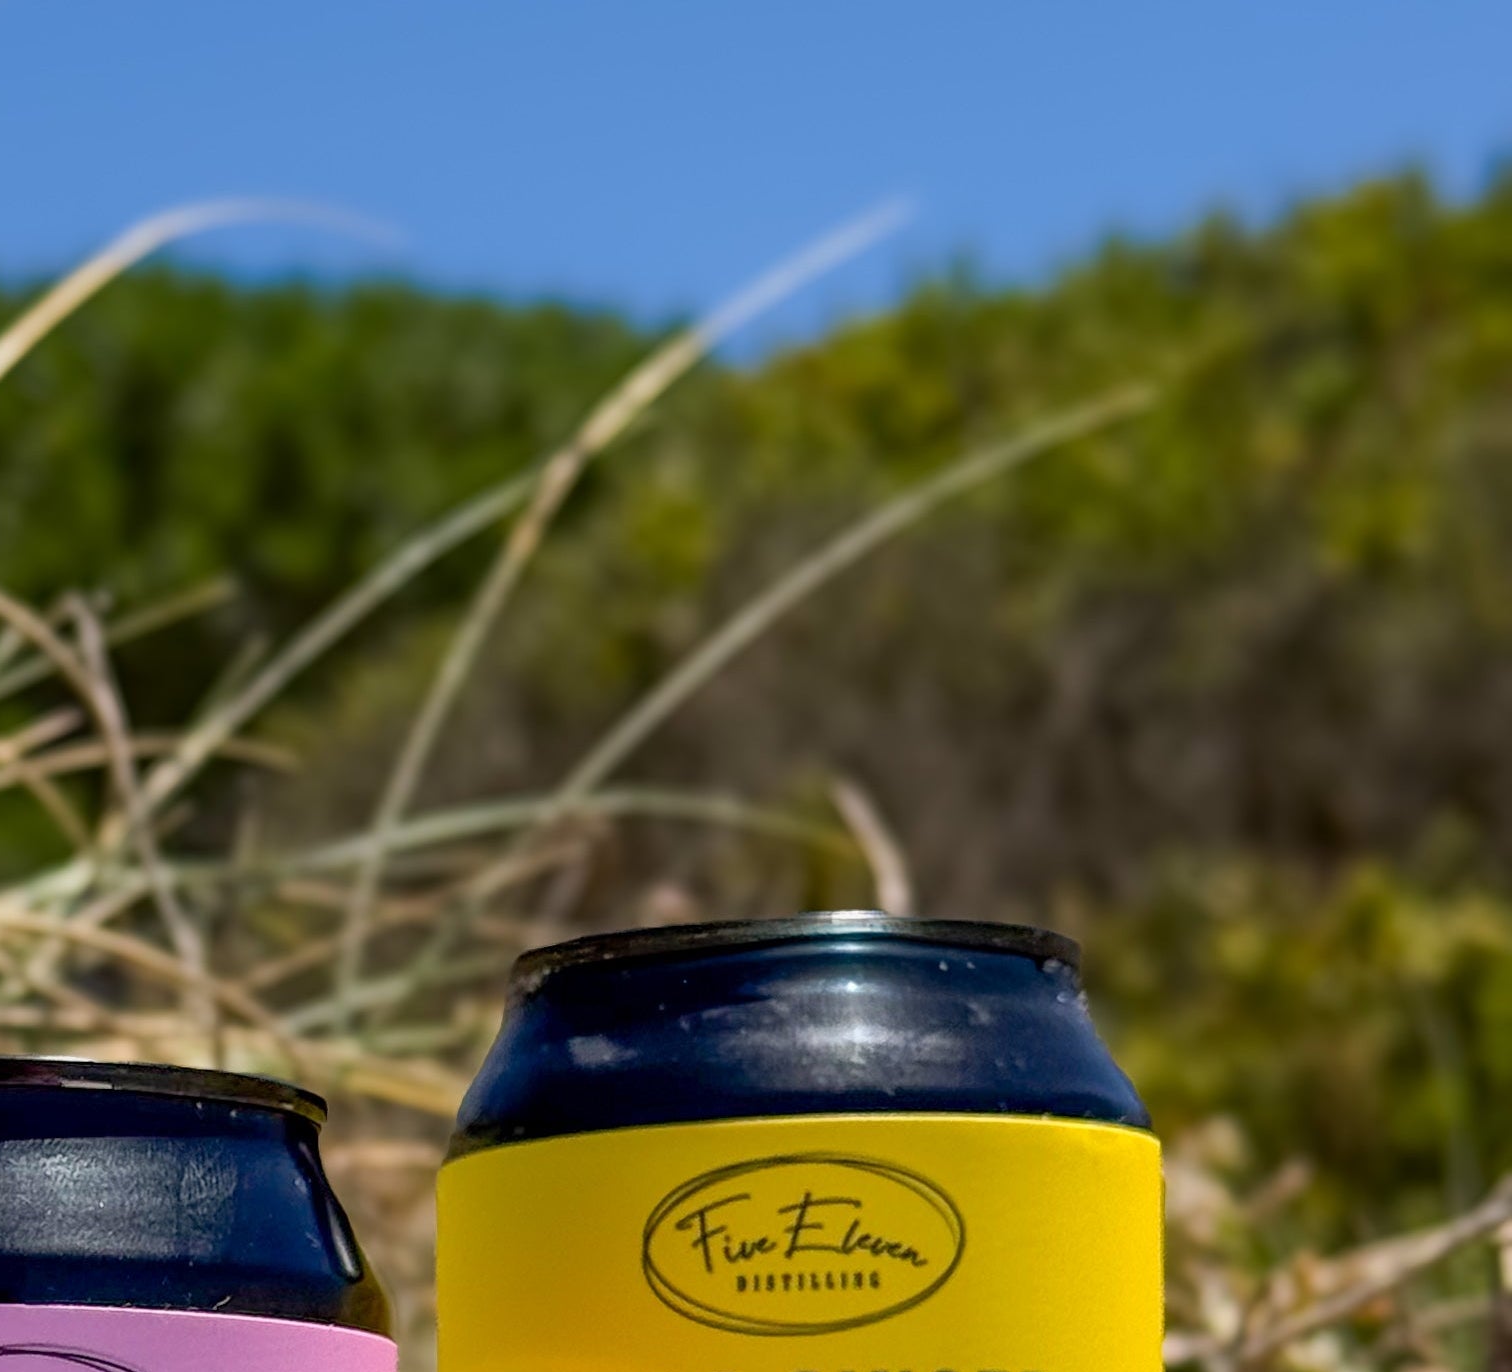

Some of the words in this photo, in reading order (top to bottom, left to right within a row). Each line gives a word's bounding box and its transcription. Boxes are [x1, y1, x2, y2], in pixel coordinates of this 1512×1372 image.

[674, 1193, 777, 1273] Five
[777, 1191, 928, 1269] Eleven
[736, 1270, 882, 1292] DISTILLING
